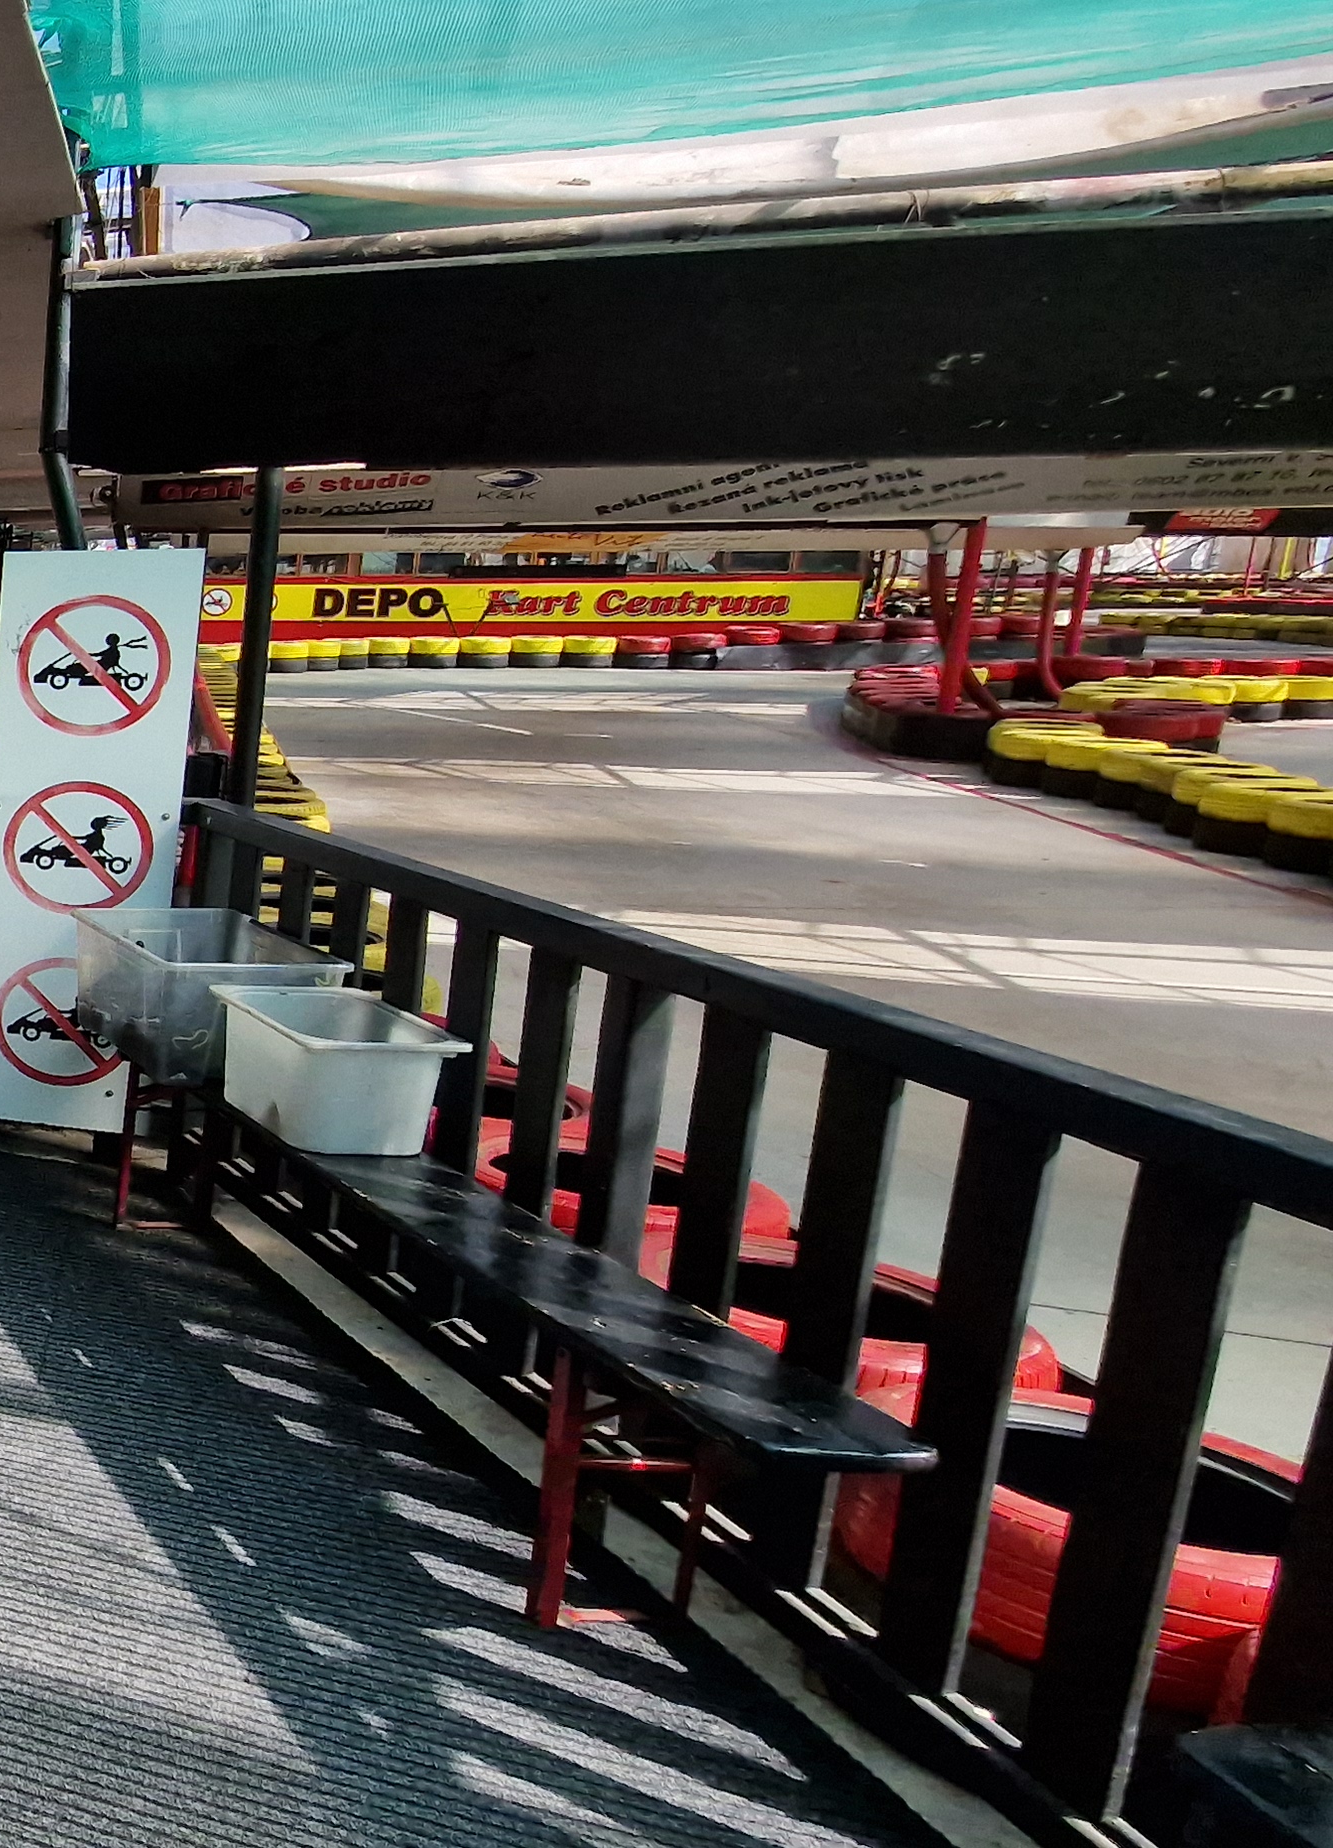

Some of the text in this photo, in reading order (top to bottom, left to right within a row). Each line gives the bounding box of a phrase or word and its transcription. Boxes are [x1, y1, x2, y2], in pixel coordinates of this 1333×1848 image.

[159, 472, 432, 499] Graficé studio
[240, 504, 323, 517] Voba
[311, 588, 791, 617] DEPO Kart Centrum
